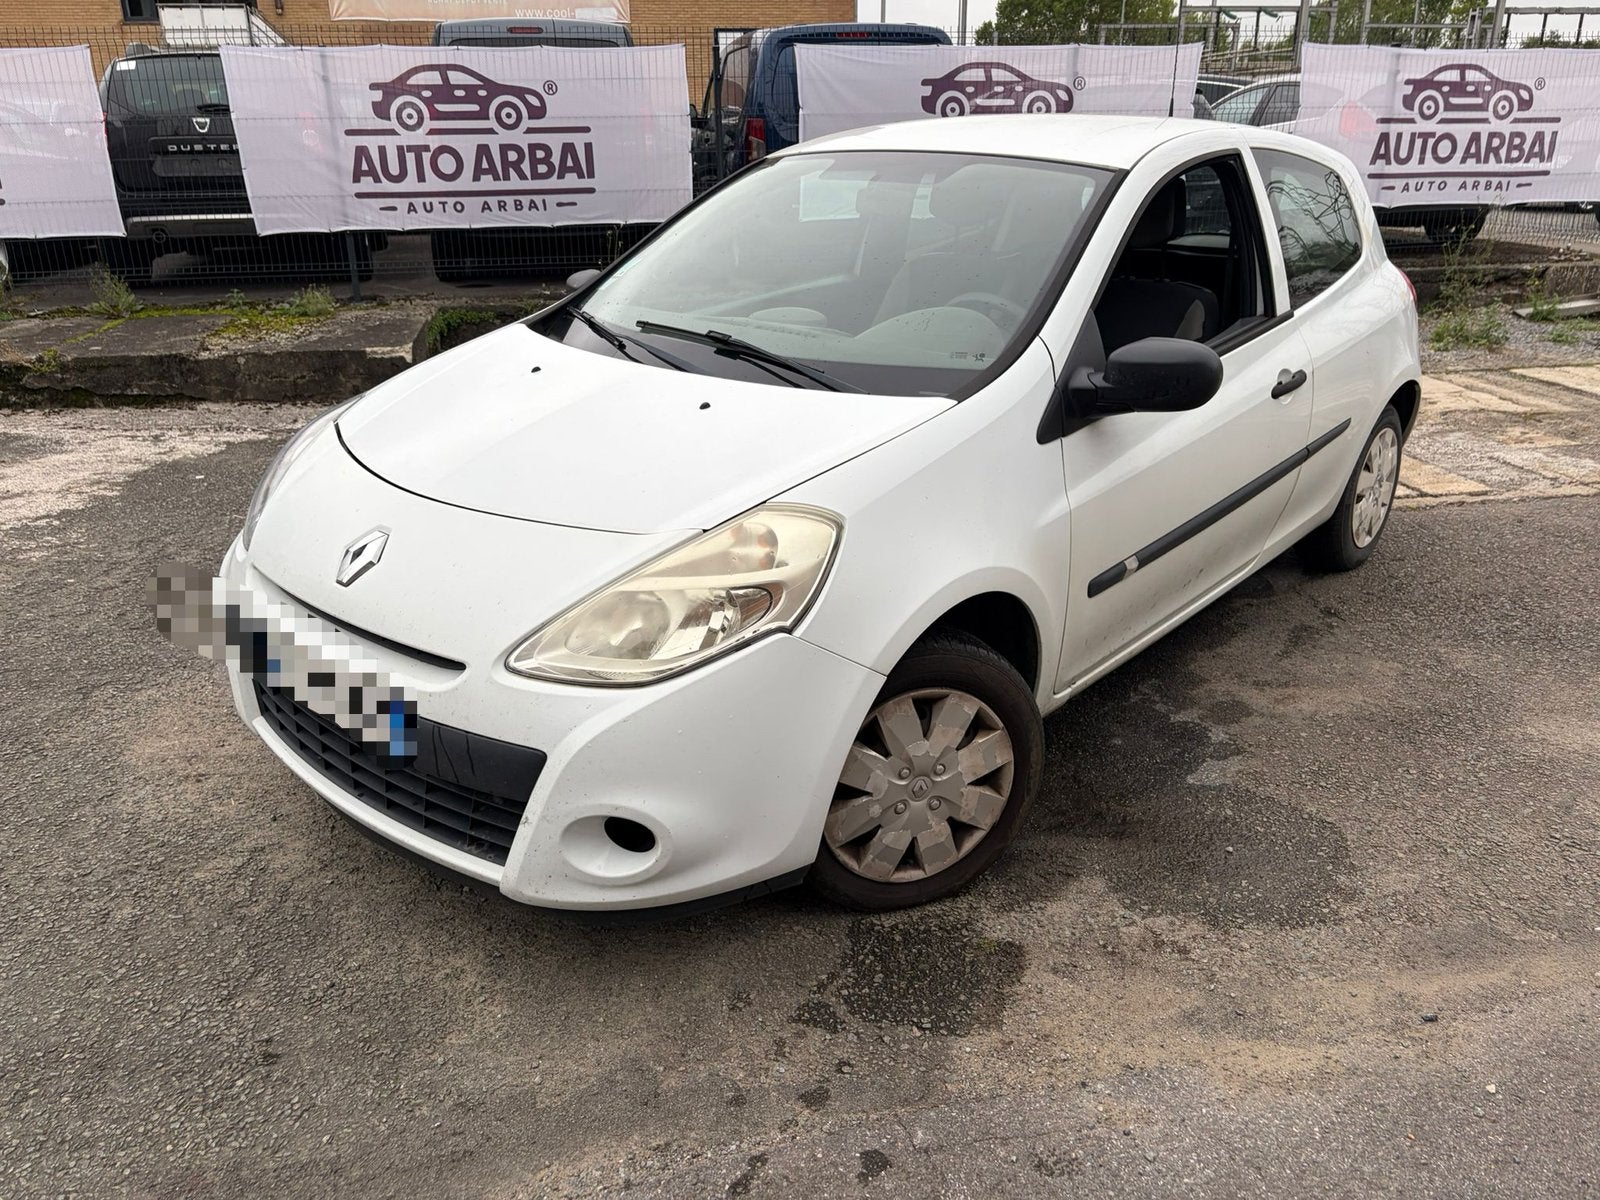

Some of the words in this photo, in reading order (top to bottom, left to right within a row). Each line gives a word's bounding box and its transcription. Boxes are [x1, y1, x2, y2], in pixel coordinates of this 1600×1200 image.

[1369, 132, 1458, 166] AUTO
[1460, 130, 1558, 164] ARBAI
[352, 144, 464, 184] AUTO
[472, 142, 596, 182] ARBAI
[1401, 182, 1448, 193] AUTO
[1458, 180, 1511, 192] ARBAI
[407, 201, 465, 214] AUTO
[481, 199, 547, 213] ARBAI
